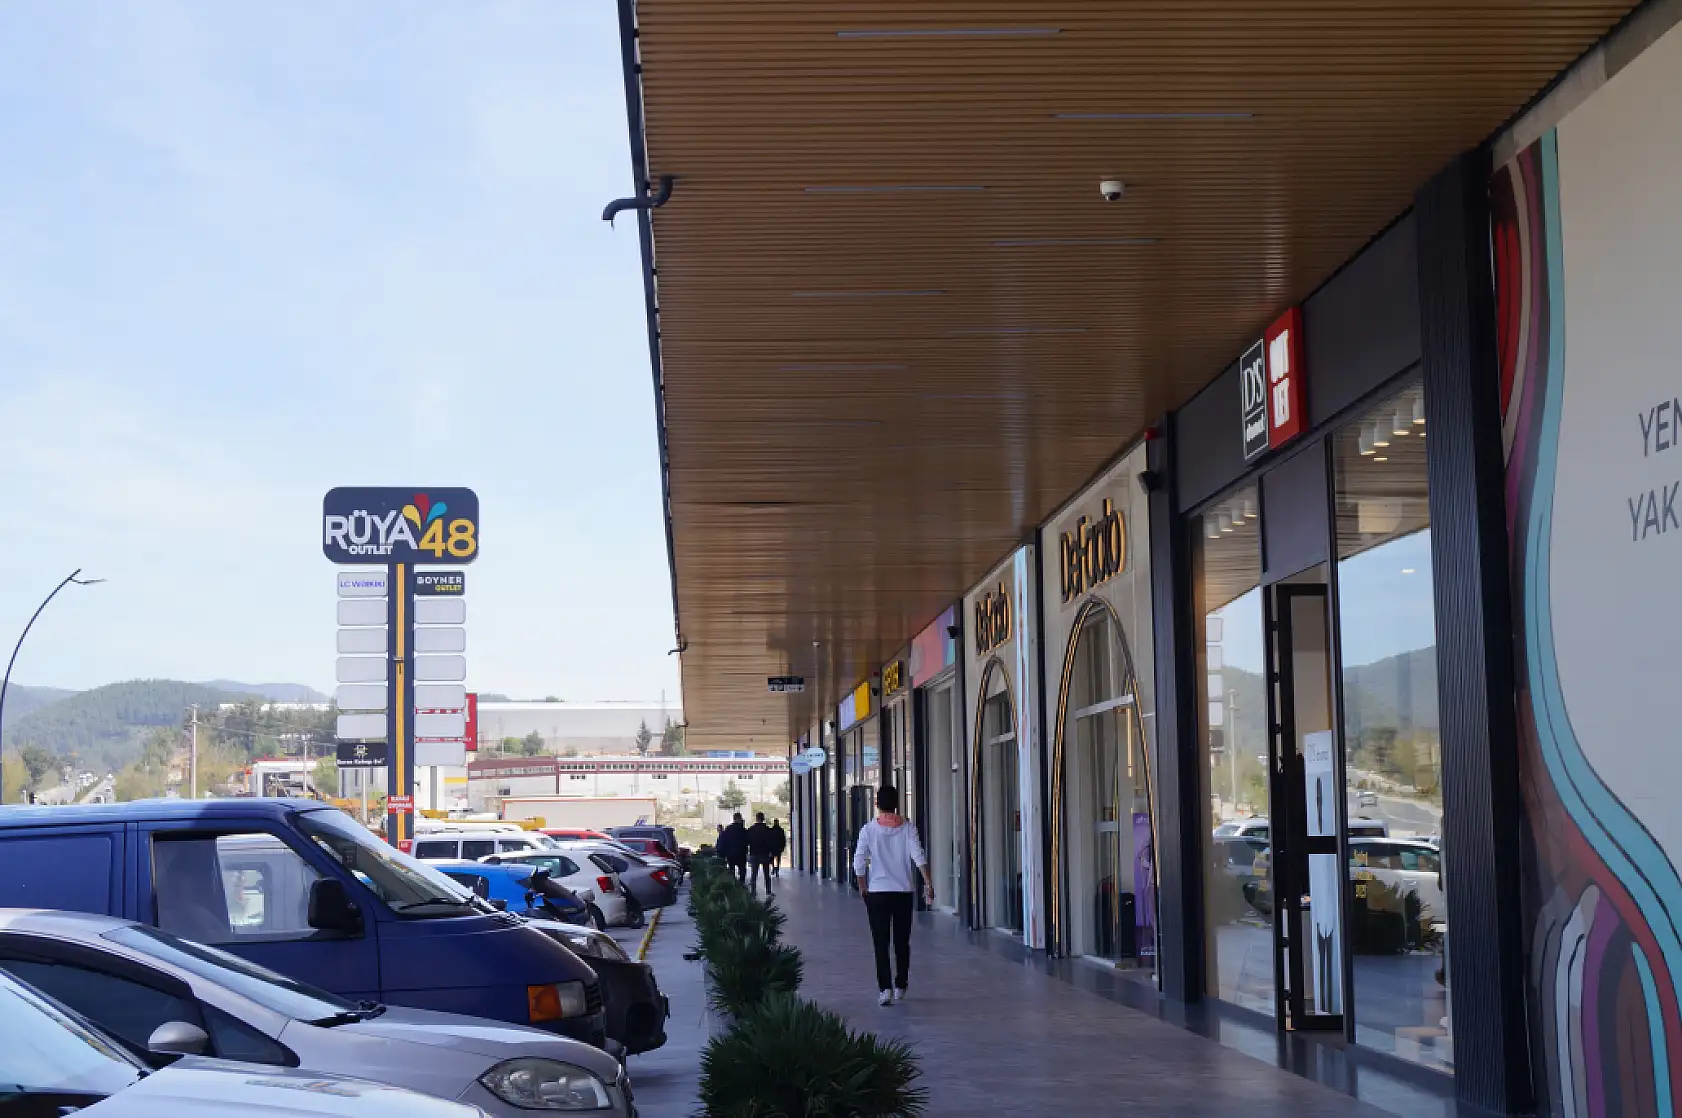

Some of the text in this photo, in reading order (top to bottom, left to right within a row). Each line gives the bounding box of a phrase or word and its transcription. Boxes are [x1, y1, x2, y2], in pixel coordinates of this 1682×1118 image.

[1628, 480, 1680, 542] YAK
[325, 509, 477, 558] RÜYA 48
[348, 545, 393, 555] OUTLET
[416, 576, 462, 584] BOYNER
